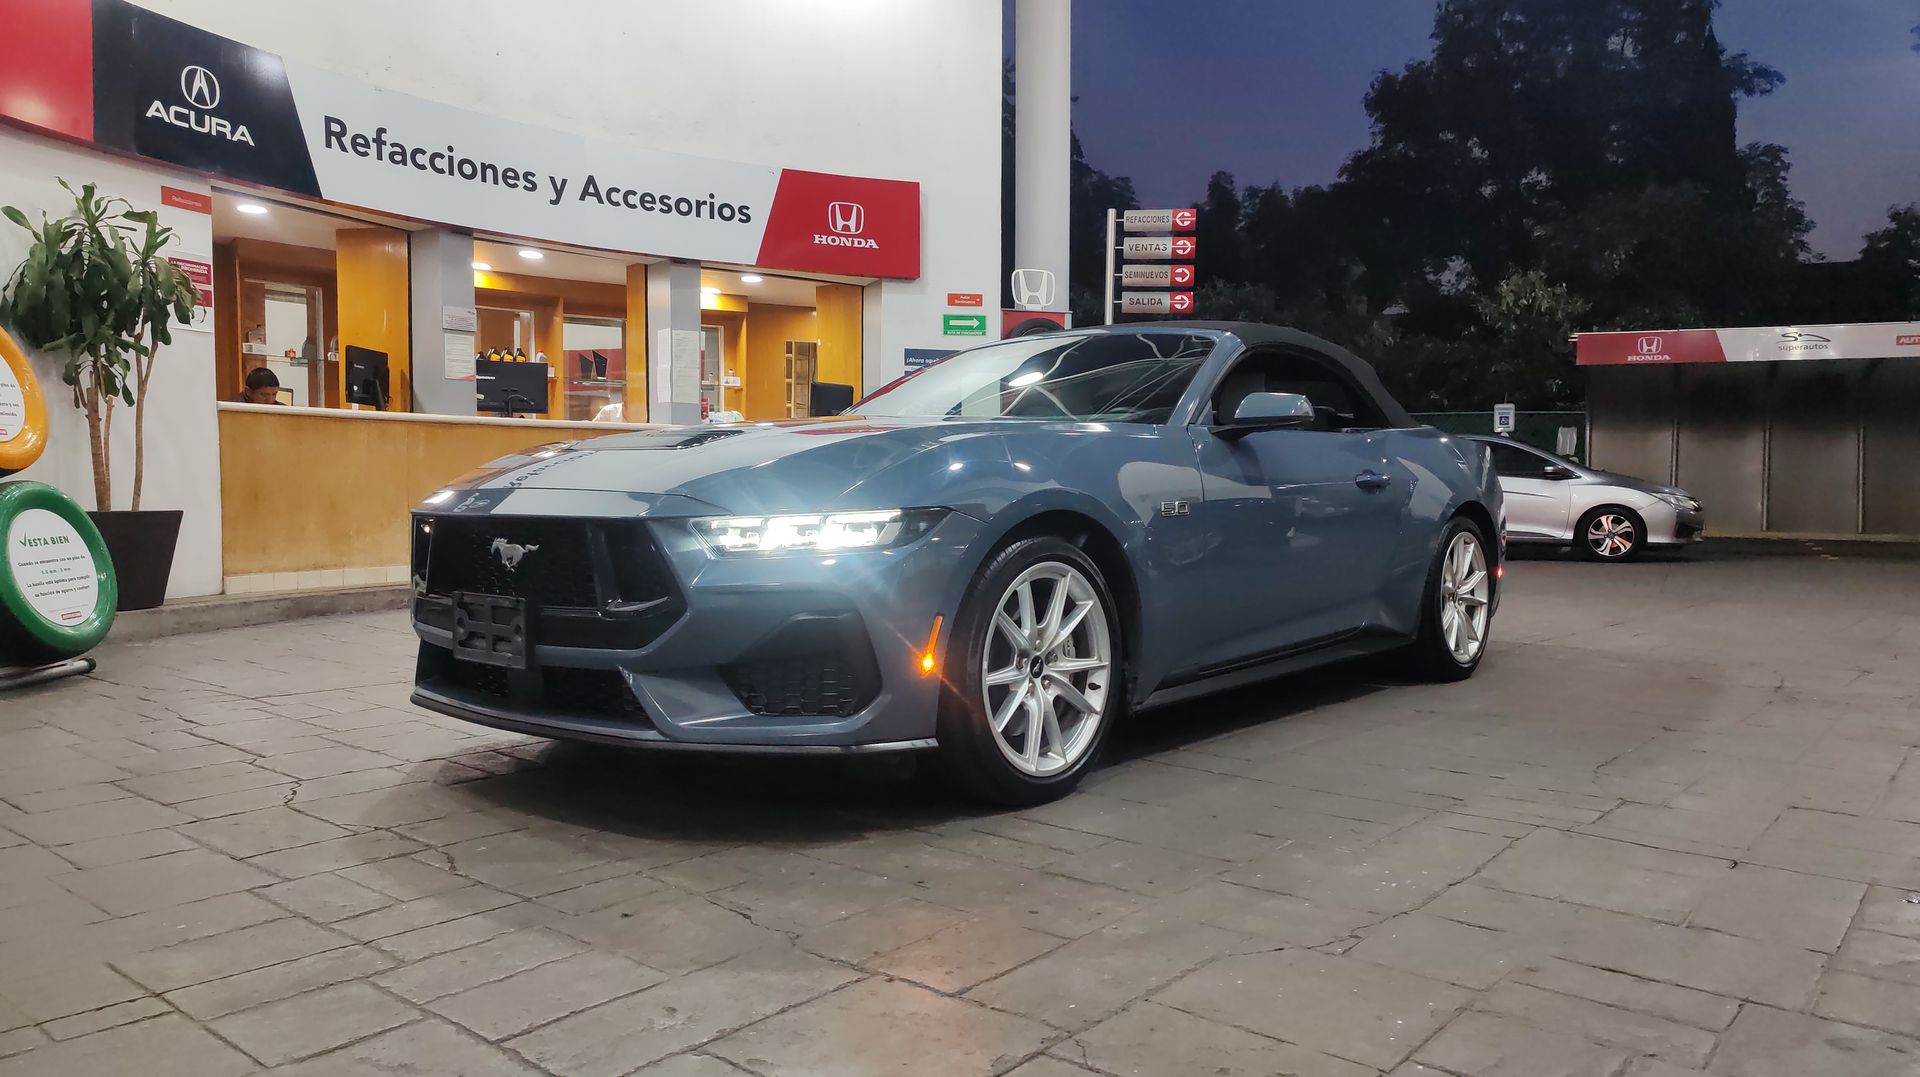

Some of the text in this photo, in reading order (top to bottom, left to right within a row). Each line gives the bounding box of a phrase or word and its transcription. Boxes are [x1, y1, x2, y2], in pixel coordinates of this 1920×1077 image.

[146, 100, 255, 147] ACURA
[324, 115, 751, 224] Refacciones y Accesorios
[1125, 215, 1170, 224] REFACCIONES
[813, 234, 879, 249] HONDA
[1128, 243, 1168, 252] VENTAS
[1124, 271, 1168, 279] SEMINUEVOS
[1128, 297, 1163, 306] SALIDA
[1778, 343, 1829, 351] superautos
[50, 535, 70, 545] BIEN
